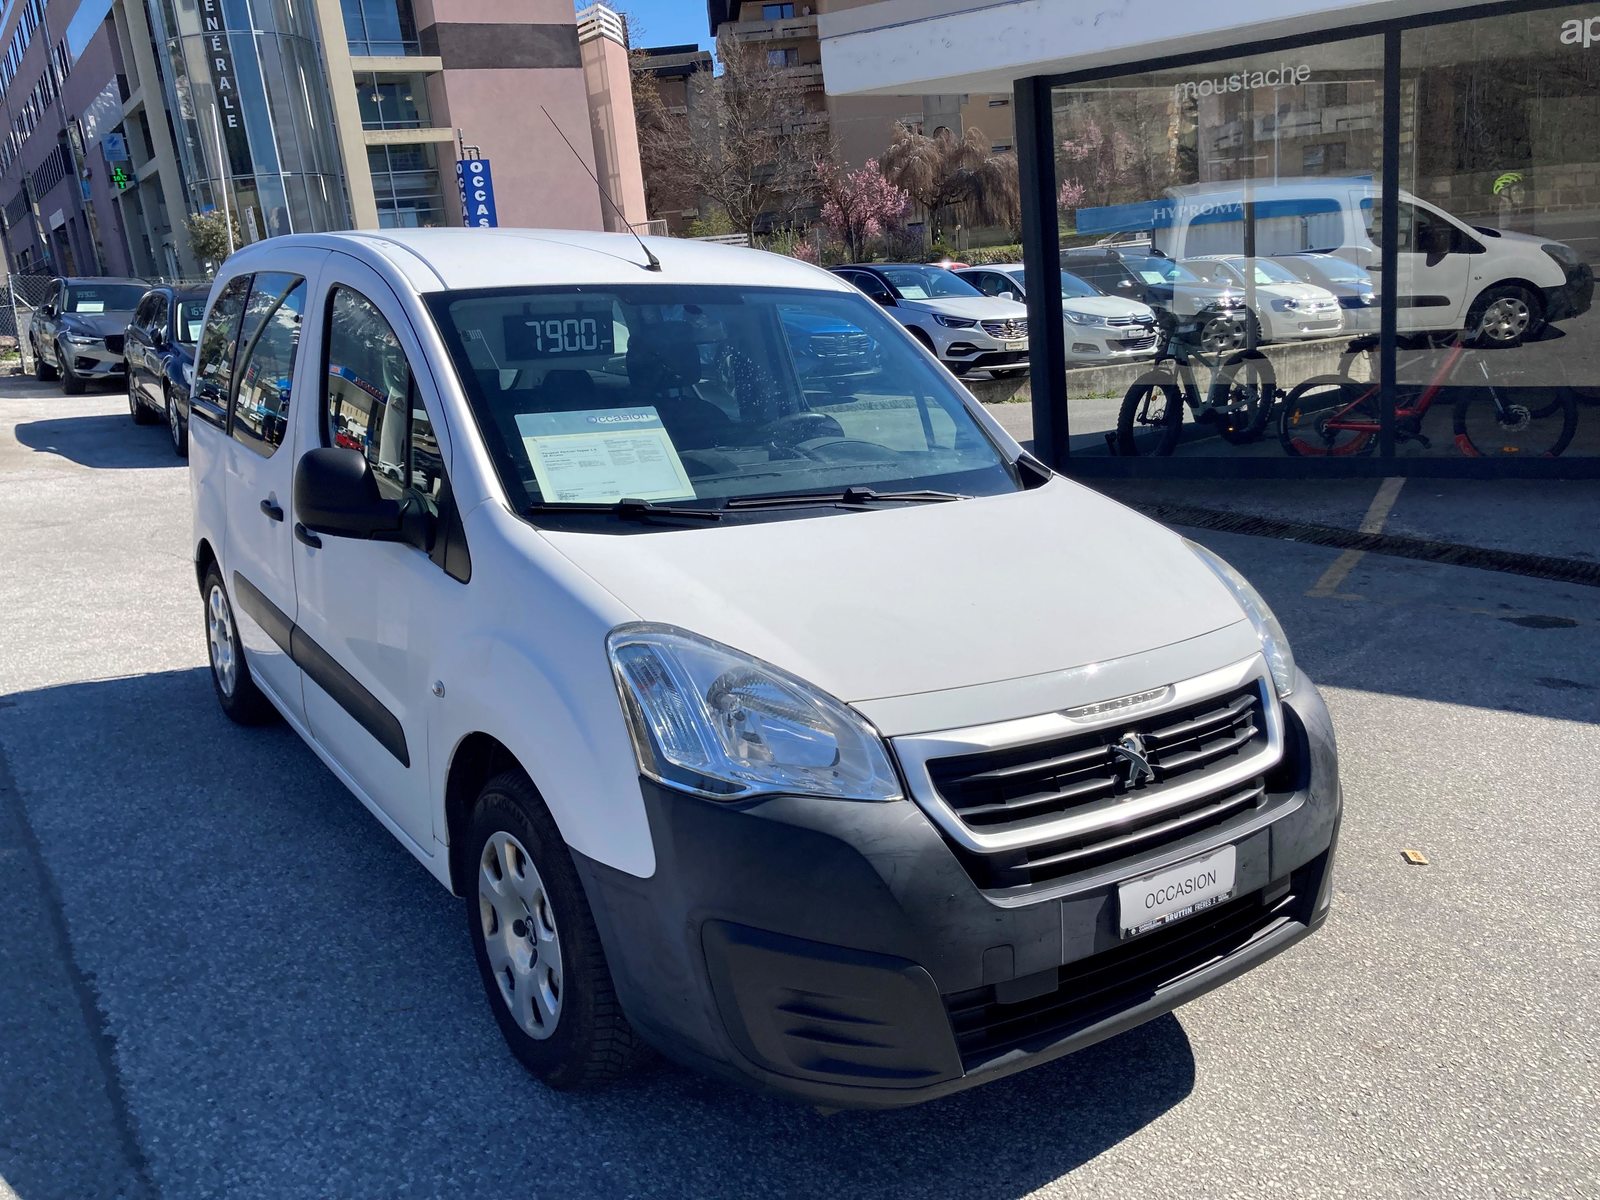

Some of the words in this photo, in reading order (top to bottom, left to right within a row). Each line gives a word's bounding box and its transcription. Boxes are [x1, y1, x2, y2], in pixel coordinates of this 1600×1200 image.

[1173, 63, 1311, 99] moustache
[586, 413, 649, 424] Occasion
[1145, 869, 1217, 909] OCCASION
[1165, 905, 1193, 923] BRUTTIN
